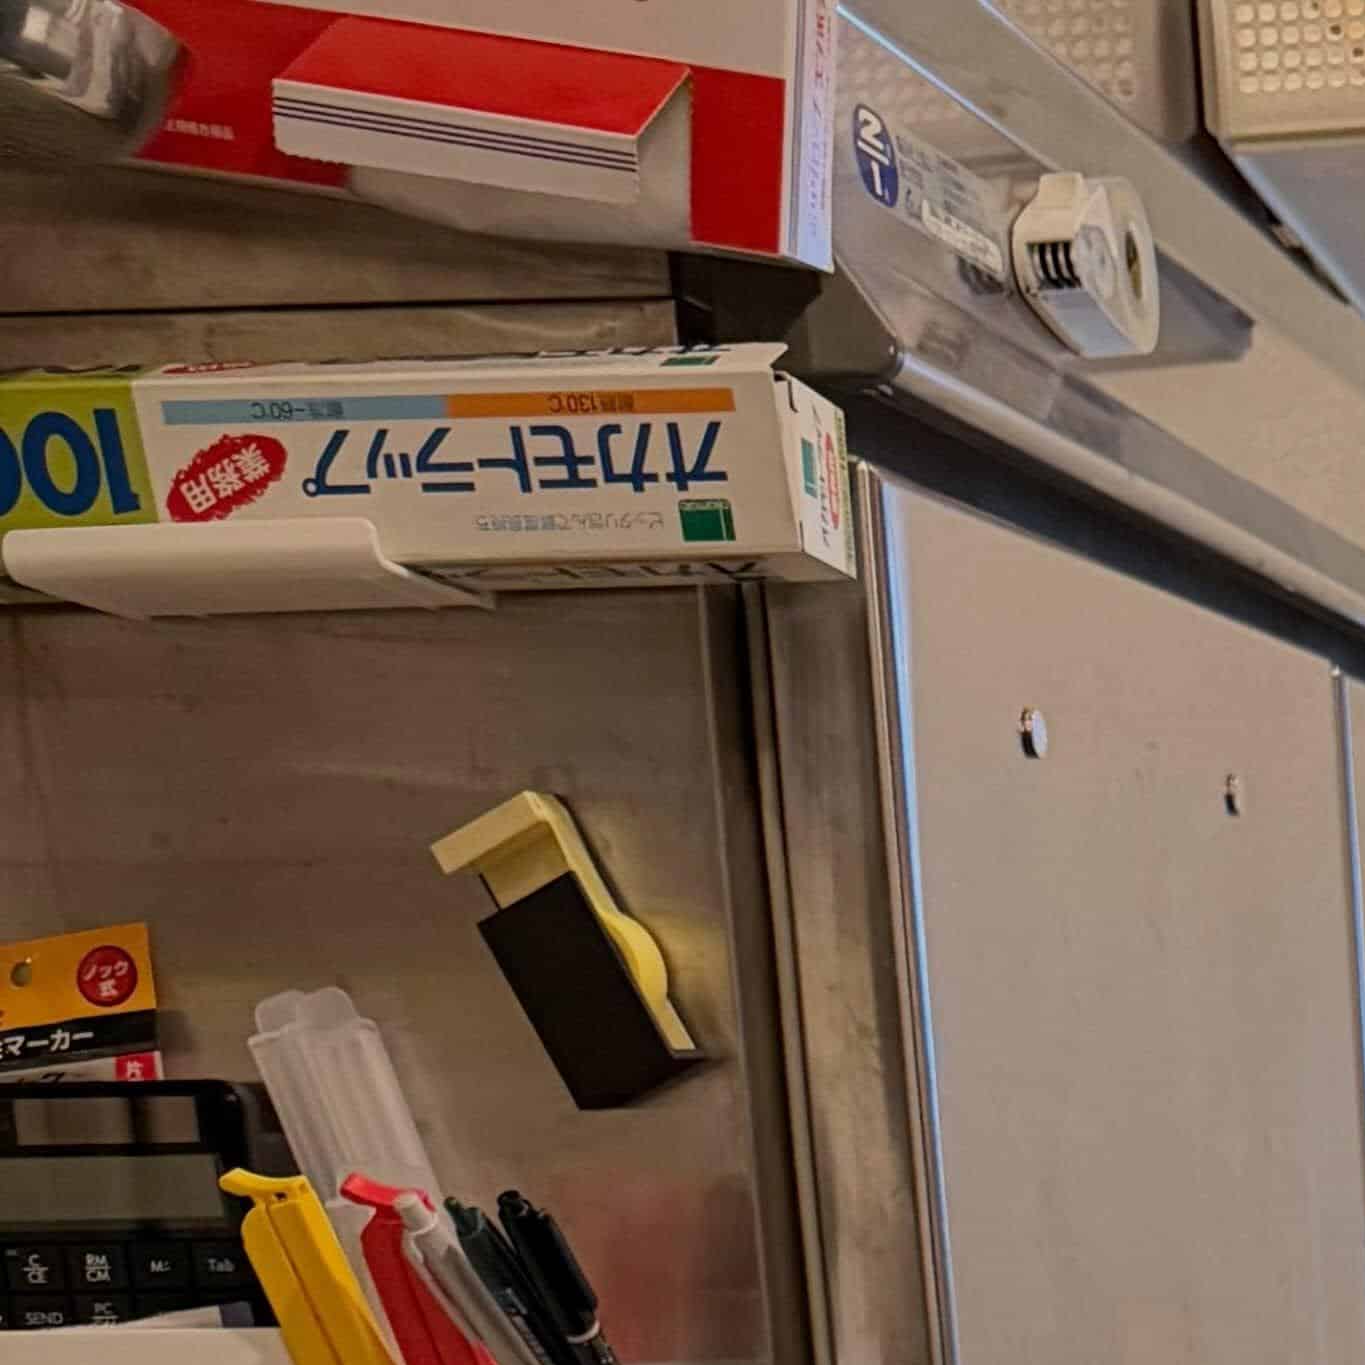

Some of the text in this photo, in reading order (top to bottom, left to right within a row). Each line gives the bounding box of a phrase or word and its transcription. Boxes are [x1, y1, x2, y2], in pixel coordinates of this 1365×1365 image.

[0, 407, 142, 517] 10
[180, 443, 272, 514] 業務用
[302, 420, 729, 498] オカモトラップ
[82, 960, 129, 982] ノック
[207, 1258, 235, 1272] Tab
[25, 1310, 64, 1326] SEND
